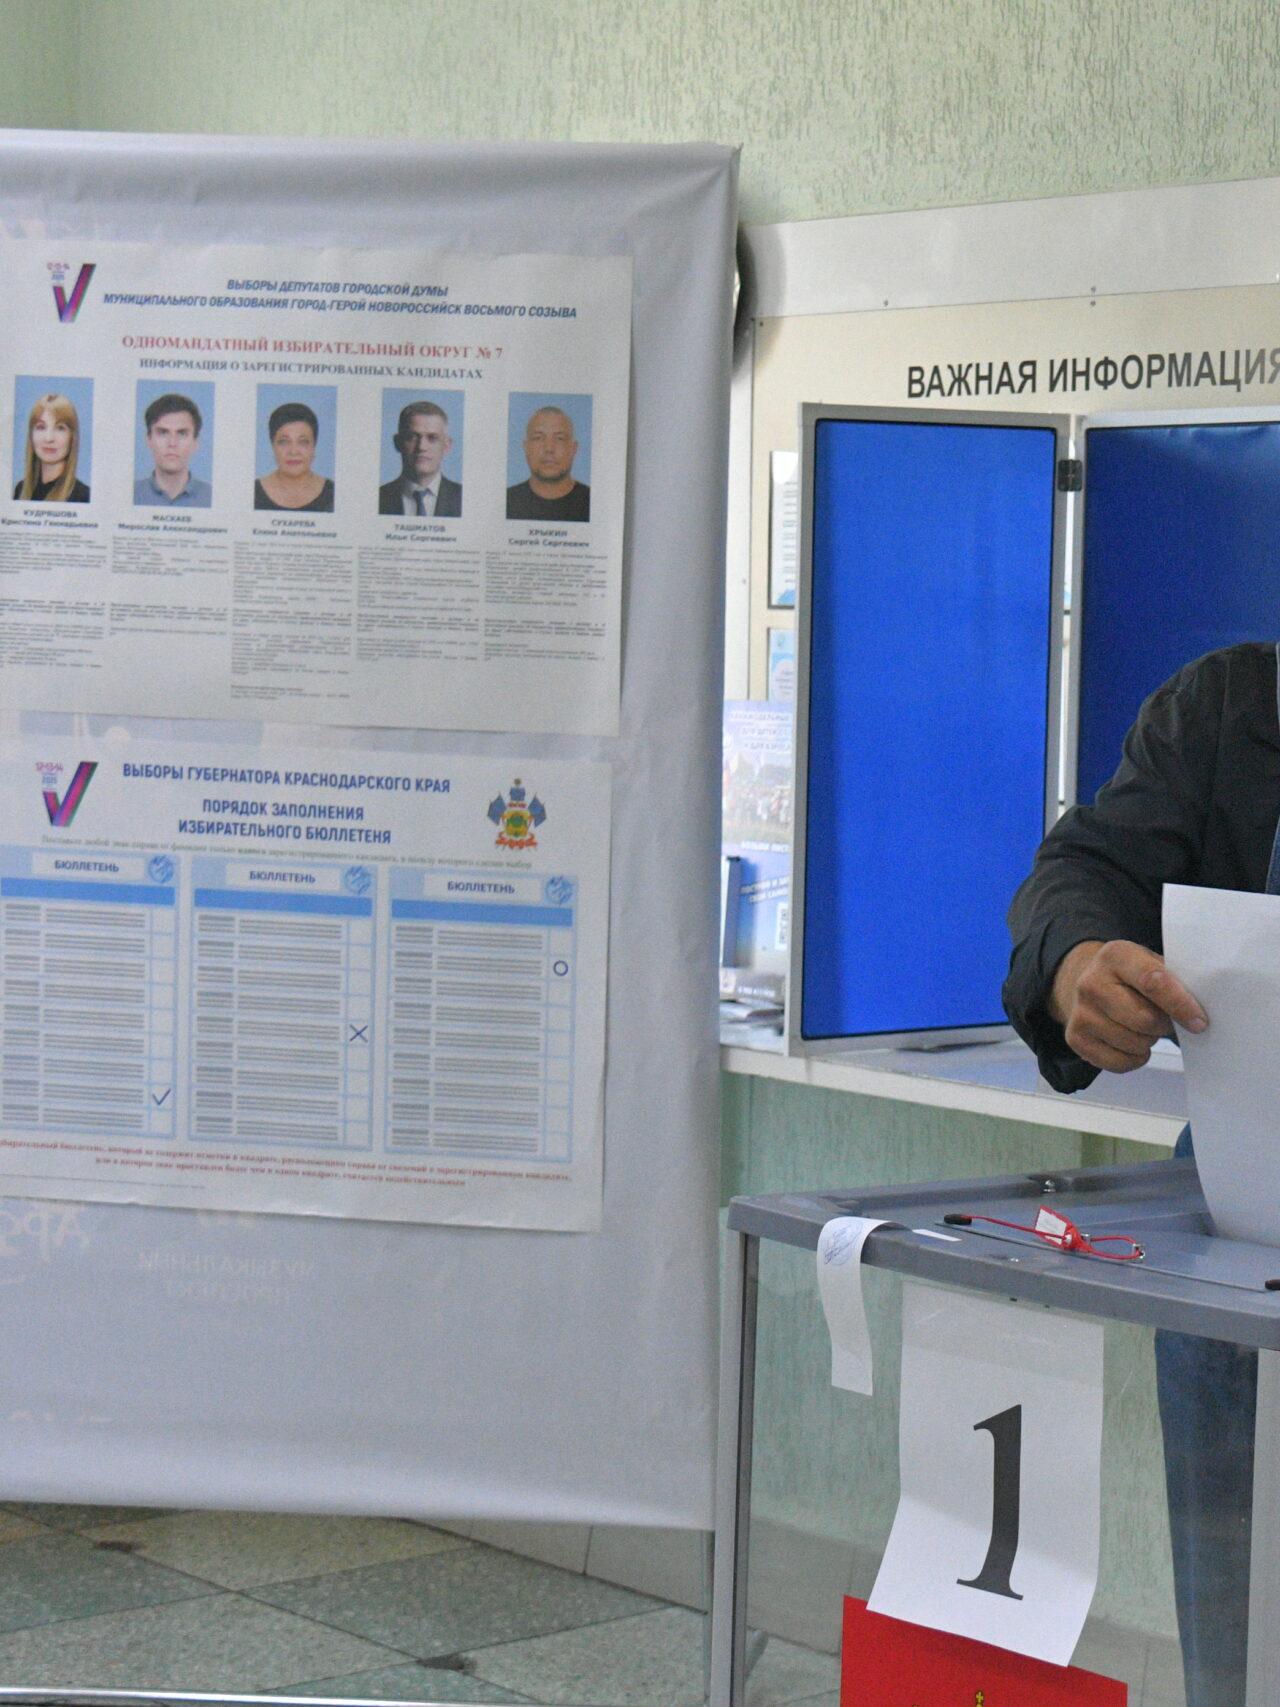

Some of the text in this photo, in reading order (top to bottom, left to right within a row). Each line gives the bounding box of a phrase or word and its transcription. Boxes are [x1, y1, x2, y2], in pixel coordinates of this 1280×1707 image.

[226, 279, 449, 297] ВЫБОРЫ ДЕПУТАТОВ ГОРОДСКОЙ ДУМЫ
[103, 293, 577, 318] МУНИЦИПАЛЬНОГО ОБРАЗОВАНИЯ ГОРОД-ГЕРОЙ НОВОРОССИЙСК ВОСЬМОГО СОЗЫВА
[121, 335, 504, 360] ОДНОМАНДАТНЫЙ ИЗБИРАТЕЛЬНЫЙ ОКРУГ № 7
[139, 358, 483, 379] ИНФОРМАЦИЯ О ЗАРЕГИСТРИРОВАННЫХ КАНДИДАТАХ
[907, 360, 1037, 398] ВАЖНАЯ
[122, 763, 451, 792] ВЫБОРЫ ГУБЕРНАТОРА КРАСНОДАРСКОГО КРАЯ
[202, 799, 364, 820] ПОРЯДОК ЗАПОЛНЕНИЯ
[178, 820, 392, 843] ИЗБИРАТЕЛЬНОГО БЮЛЛЕТЕНЯ
[53, 859, 120, 873] БЮЛЛЕТЕНЬ
[248, 869, 316, 884] БЮЛЛЕТЕНЬ
[446, 880, 515, 895] БЮЛЛЕТЕНЬ
[956, 1403, 1024, 1600] 1
